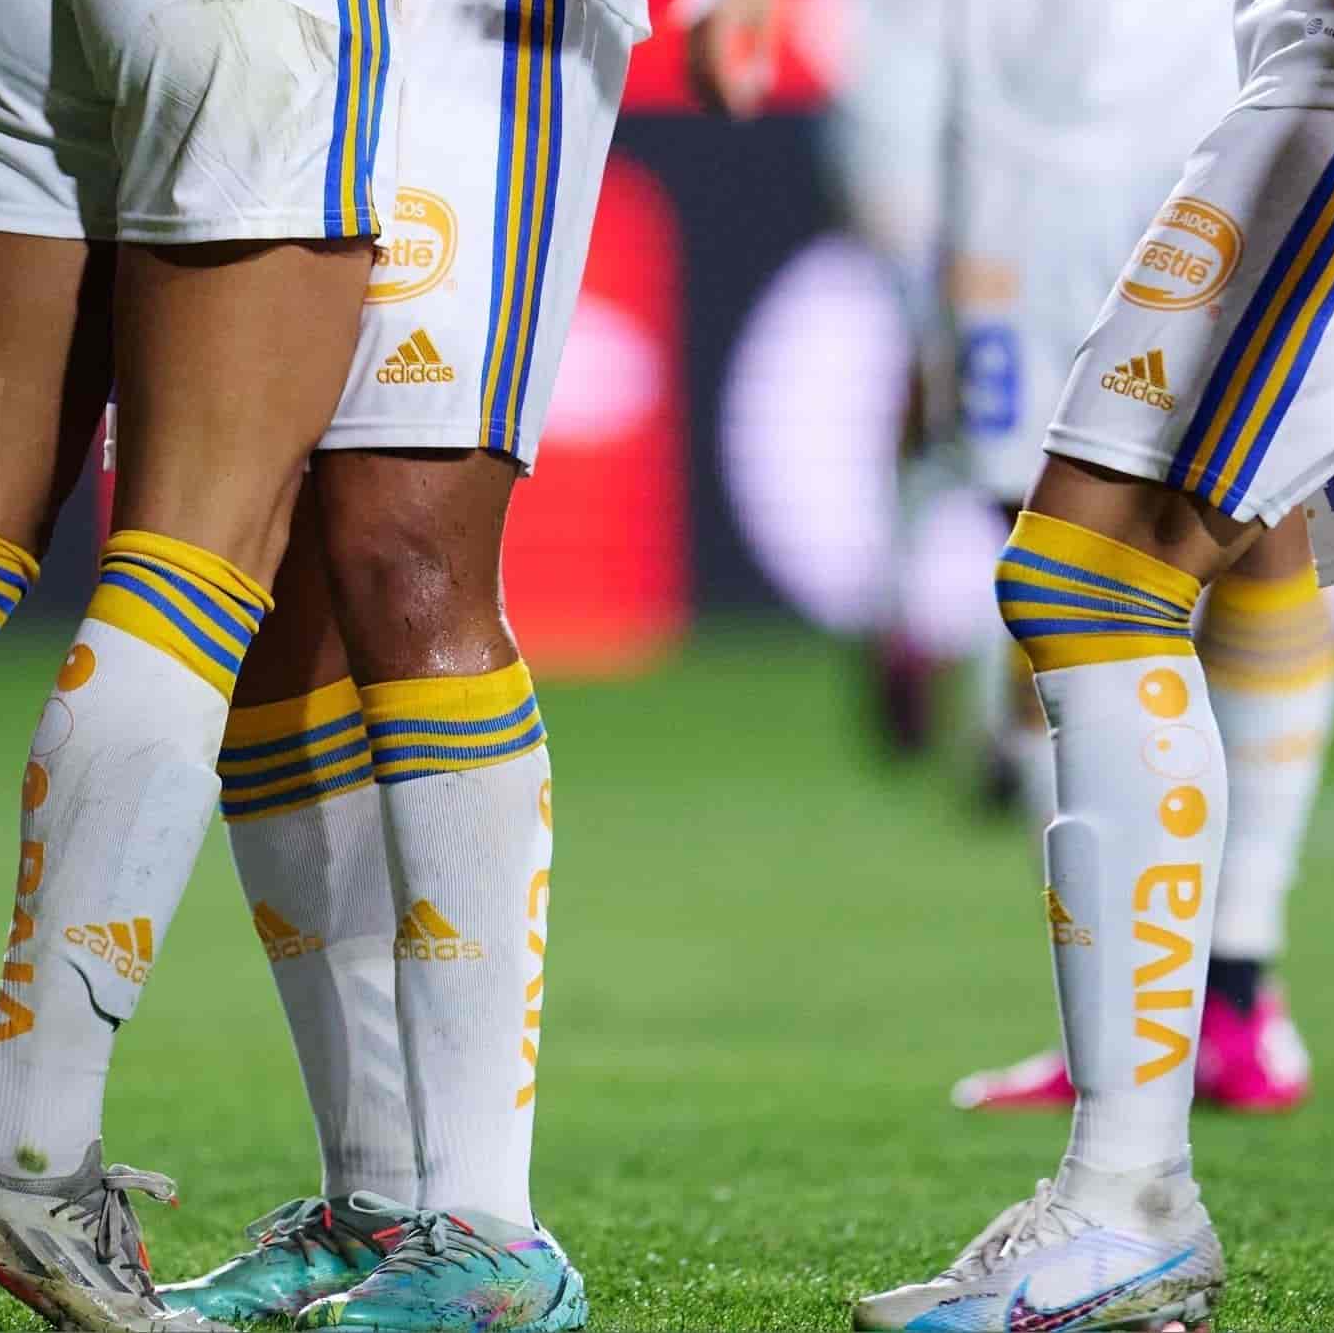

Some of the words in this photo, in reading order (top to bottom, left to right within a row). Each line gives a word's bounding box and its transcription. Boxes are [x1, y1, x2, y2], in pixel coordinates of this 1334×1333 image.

[376, 364, 454, 385] adidas
[1099, 372, 1175, 412] adidas
[1133, 862, 1204, 1087] viva
